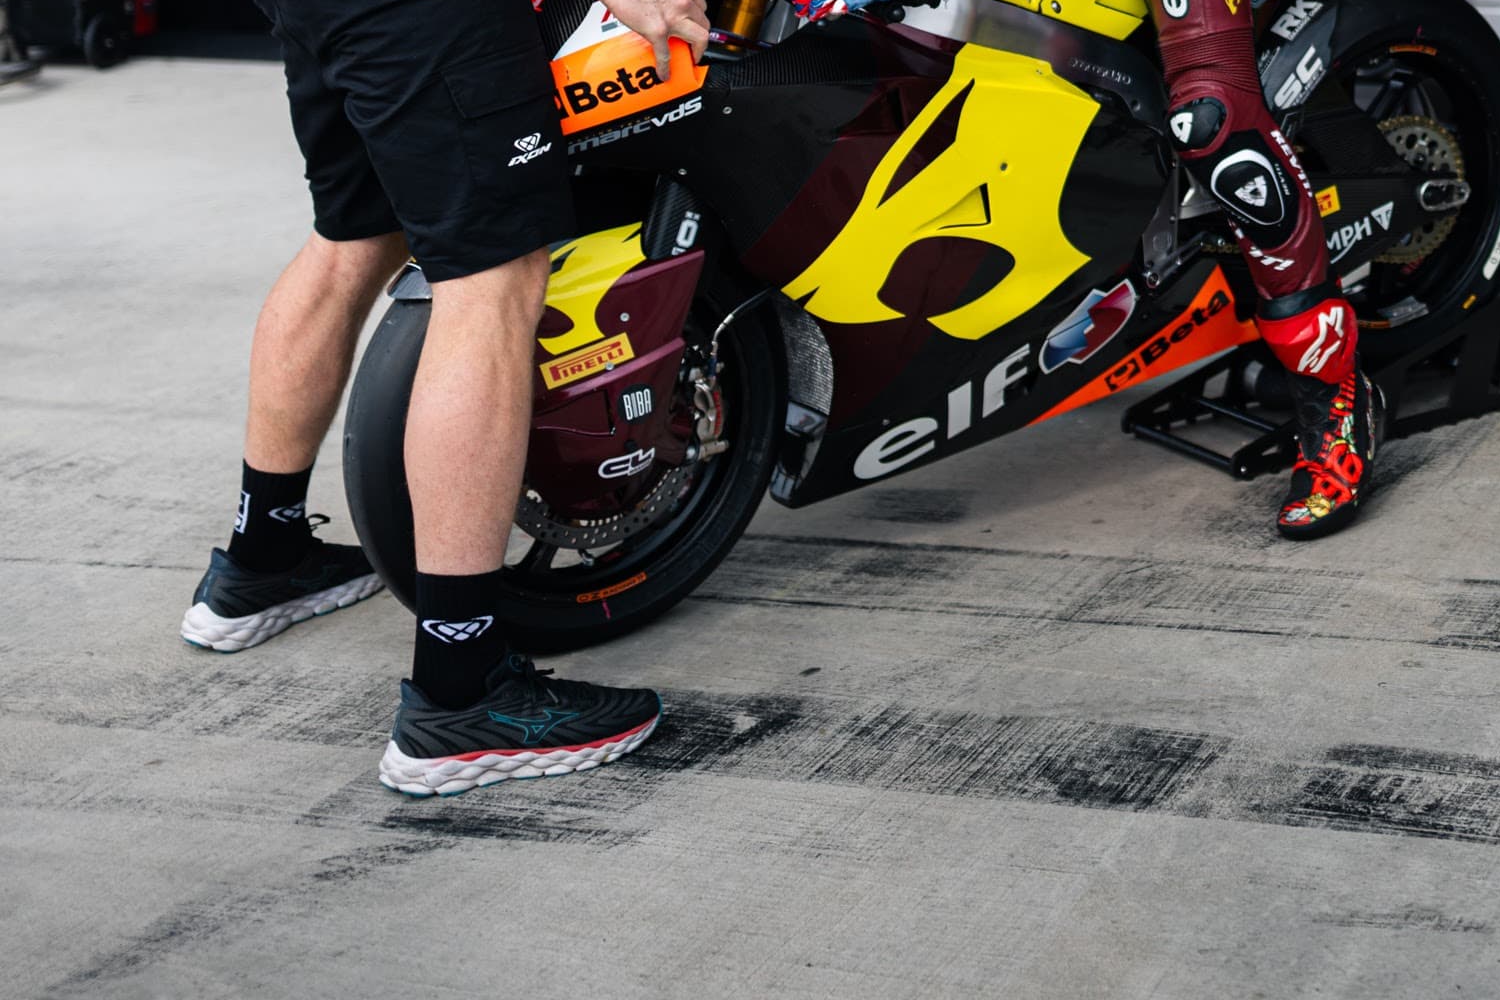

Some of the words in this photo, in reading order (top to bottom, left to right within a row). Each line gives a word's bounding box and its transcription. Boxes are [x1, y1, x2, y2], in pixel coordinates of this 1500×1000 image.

[563, 65, 664, 116] Beta
[1274, 44, 1324, 110] SC
[508, 142, 552, 167] IXON
[1140, 289, 1233, 368] Beta
[550, 341, 625, 382] PIRELLI
[623, 388, 652, 421] BIBA
[854, 343, 1030, 480] elf
